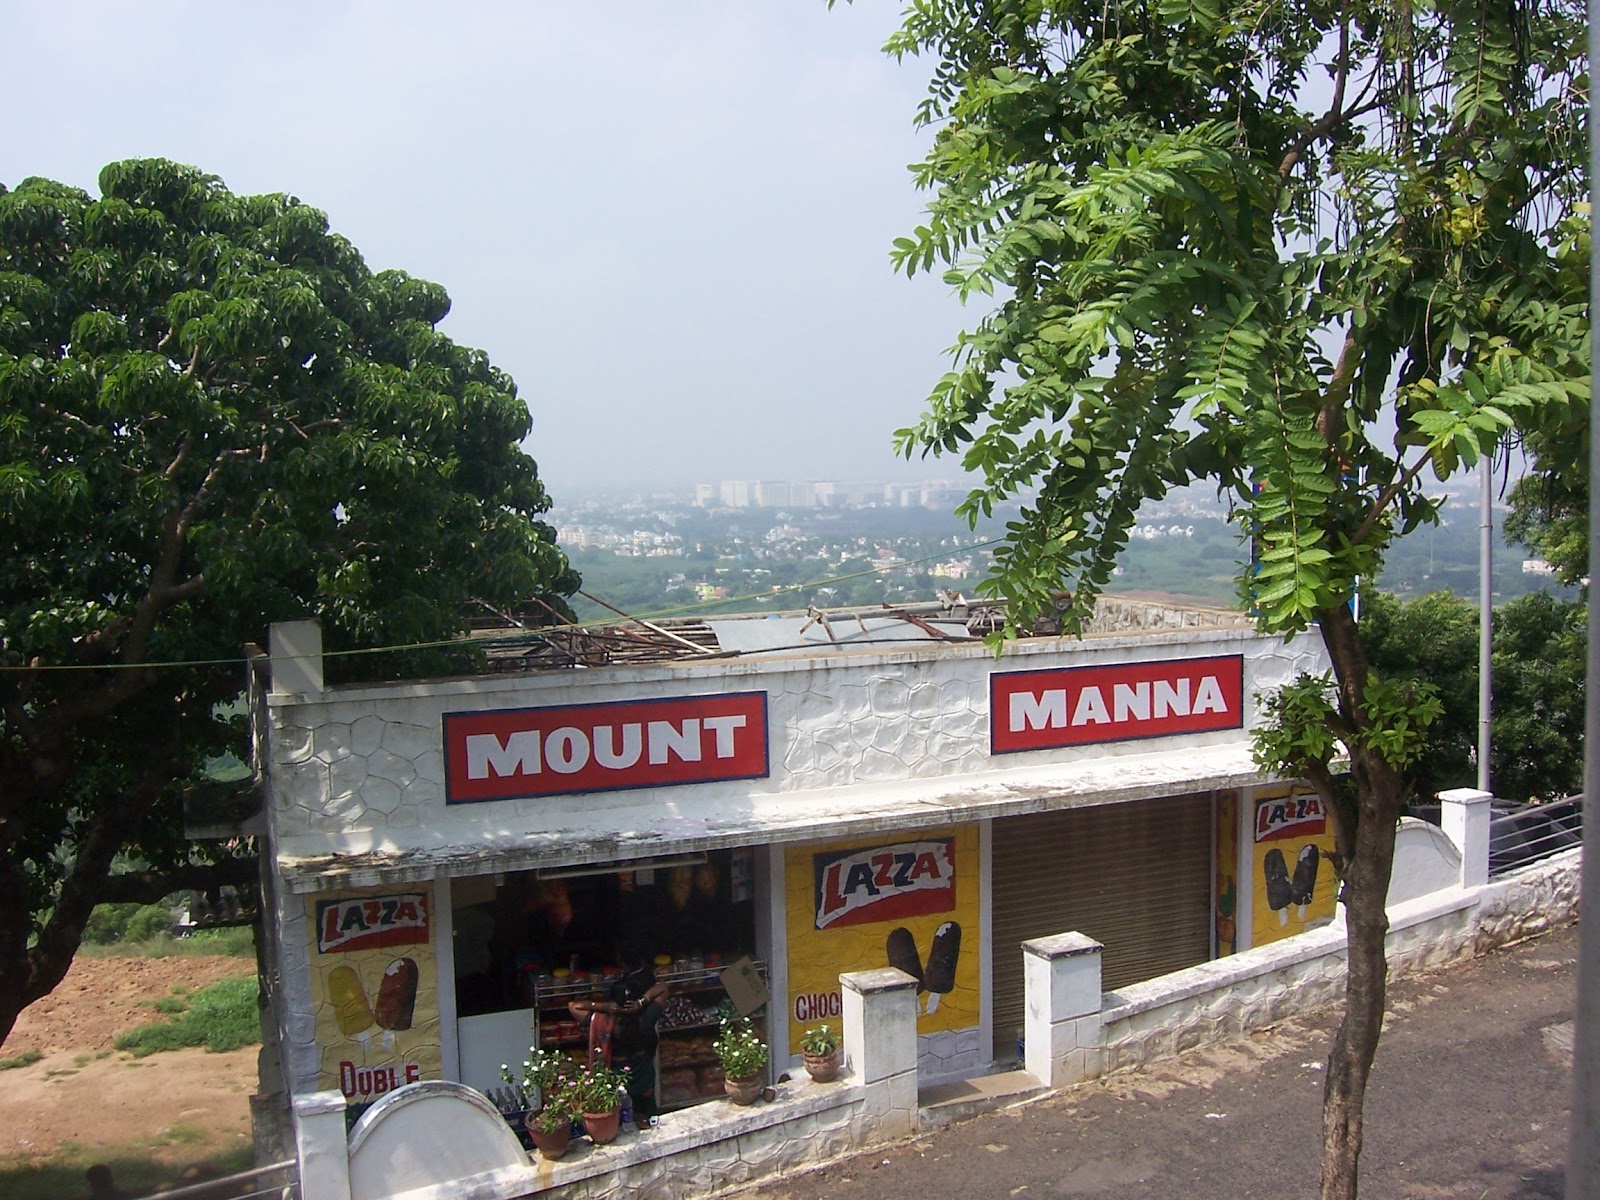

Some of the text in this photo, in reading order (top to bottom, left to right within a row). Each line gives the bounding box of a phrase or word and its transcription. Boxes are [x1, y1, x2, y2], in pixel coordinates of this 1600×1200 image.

[1009, 676, 1228, 732] MANNA
[466, 715, 747, 780] MOUNT
[1258, 799, 1320, 833] LAZZA
[824, 851, 941, 916] LAZZA
[325, 901, 418, 943] LAZZA
[795, 991, 843, 1021] CHOC
